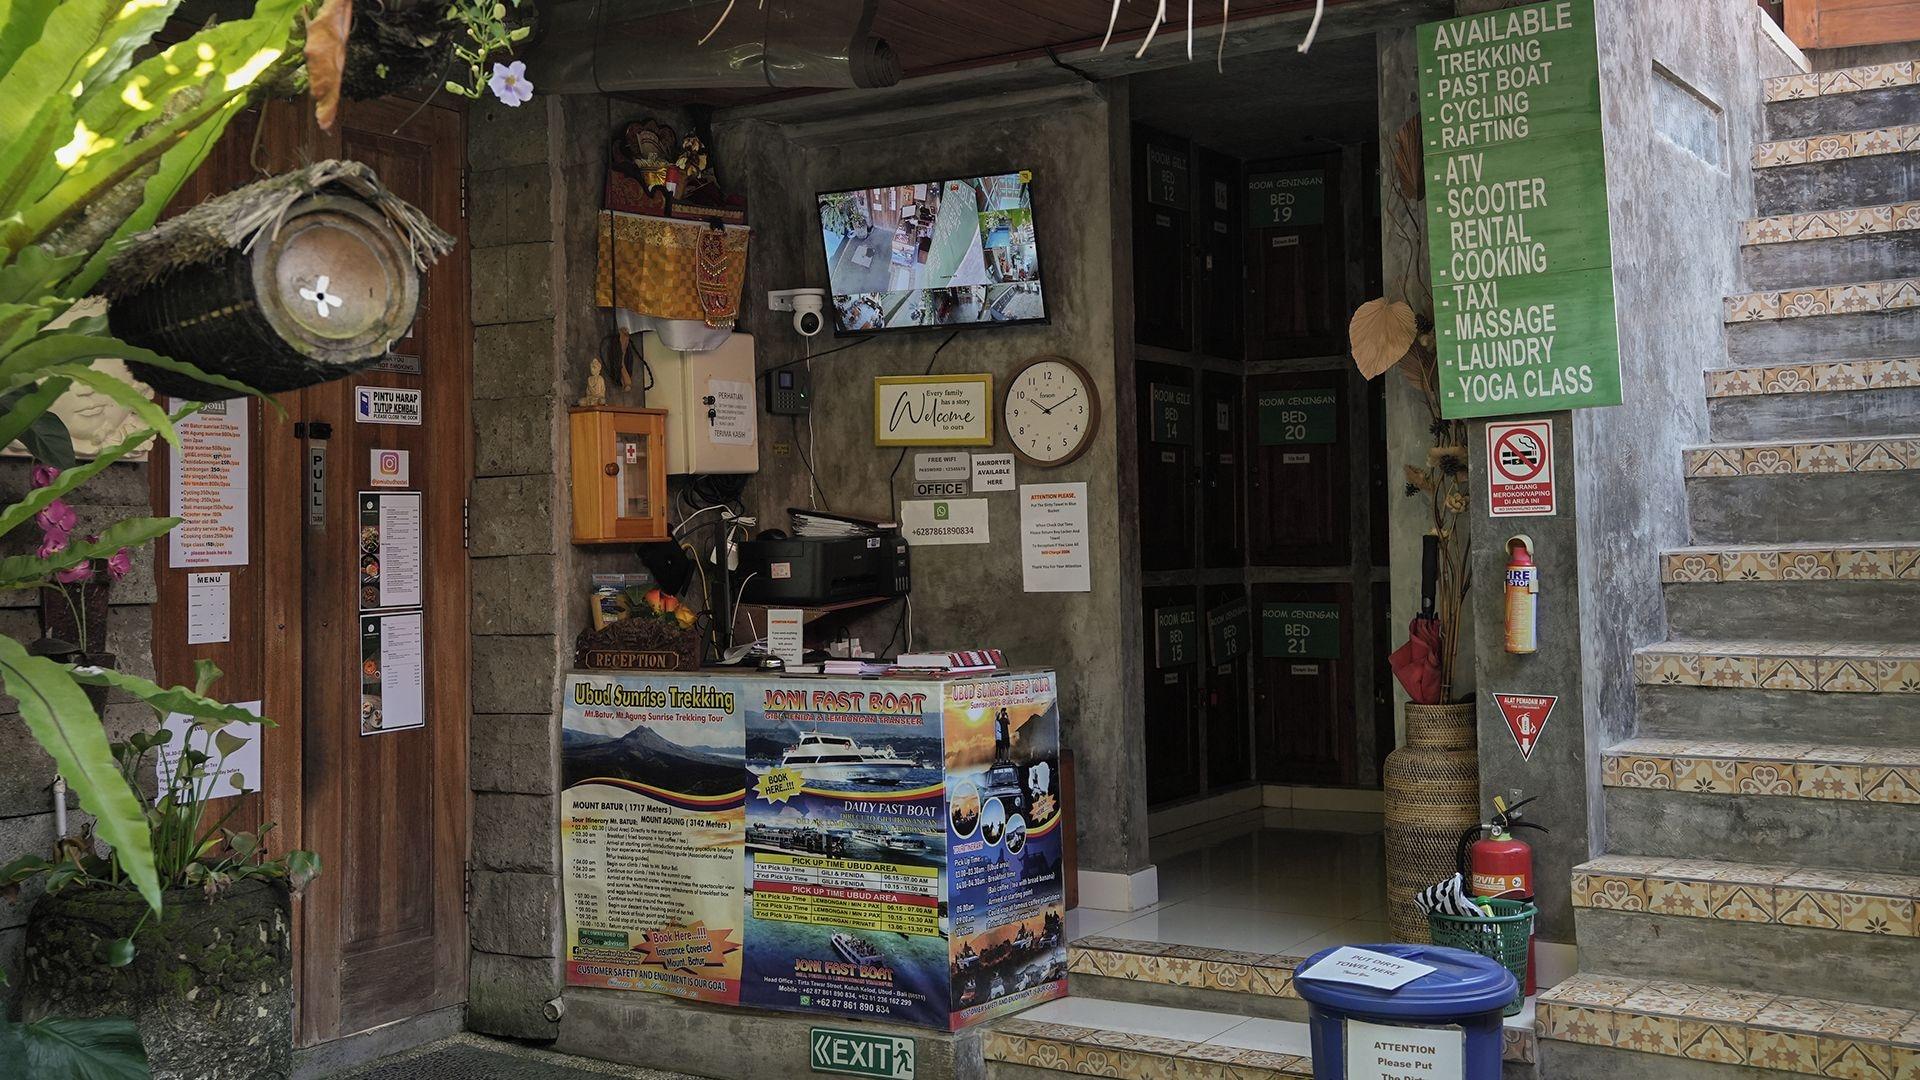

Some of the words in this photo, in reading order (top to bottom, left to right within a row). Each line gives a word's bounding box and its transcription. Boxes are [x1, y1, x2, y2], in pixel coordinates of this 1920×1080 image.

[1434, 3, 1573, 51] AVAILABLE
[1437, 39, 1541, 76] TREKKING
[1438, 72, 1490, 101] PAST
[1496, 62, 1553, 92] BOAT
[1440, 91, 1530, 125] CYCLING
[1442, 116, 1530, 149] RAFTING
[1446, 153, 1484, 186] ATV
[1249, 181, 1274, 190] ROOM
[1276, 176, 1324, 189] CENINGAN
[1270, 192, 1295, 206] BED
[1448, 177, 1548, 218] SCOOTER
[1272, 207, 1293, 222] 19
[1451, 214, 1532, 251] RENTAL
[1451, 242, 1547, 282] COOKING
[1453, 281, 1499, 311] TAXI
[1455, 304, 1557, 340] MASSAGE
[1457, 335, 1554, 371] LAUNDRY
[1028, 377, 1036, 386] 11
[1043, 372, 1052, 380] 12
[1061, 375, 1065, 384] 1
[1459, 372, 1518, 403] YOGA
[1523, 364, 1594, 396] CLASS
[374, 392, 394, 401] PINTU
[395, 393, 418, 403] HARAP
[718, 391, 743, 400] PERHATIAN
[926, 390, 943, 398] Every
[945, 389, 963, 397] family
[1016, 391, 1025, 399] 10
[1072, 388, 1078, 397] 2
[956, 399, 970, 407] story
[1259, 398, 1285, 407] ROOM
[1287, 395, 1336, 406] CENINGAN
[374, 403, 393, 412] TUTUP
[394, 404, 418, 414] KEMBALI
[889, 391, 975, 432] Welcome
[1013, 409, 1019, 417] 9
[1078, 406, 1083, 414] 3
[1281, 410, 1307, 424] BED
[714, 429, 732, 438] TERIMA
[733, 430, 746, 438] KASIH
[1019, 427, 1025, 435] 8
[1073, 424, 1078, 432] 4
[1285, 425, 1306, 440] 20
[1031, 439, 1037, 448] 7
[1046, 444, 1051, 452] 6
[1062, 438, 1068, 447] 5
[313, 455, 322, 506] PULL
[1504, 483, 1538, 491] DILARANG
[917, 483, 963, 495] OFFICE
[1493, 490, 1551, 498] MEROKOK/VAPING
[912, 526, 974, 536] +6287861890834
[197, 576, 221, 584] MENU
[1159, 613, 1180, 627] ROOM
[1262, 609, 1288, 618] ROOM
[1291, 609, 1339, 619] CENINGAN
[1169, 629, 1183, 644] BED
[1284, 623, 1310, 637] BED
[1170, 644, 1183, 661] 15
[1288, 638, 1307, 653] 21
[596, 654, 666, 668] RECEPTION
[952, 684, 975, 701] UBUD
[1031, 677, 1050, 693] TOUR
[575, 682, 612, 706] Ubud
[614, 684, 666, 708] Sunrise
[668, 685, 736, 715] Trekking
[763, 689, 808, 711] JONI
[812, 690, 865, 713] FAST
[868, 692, 927, 716] BOAT
[615, 711, 646, 722] Mt.Agung
[648, 712, 674, 721] Sunrise
[675, 713, 706, 723] Trekking
[708, 715, 724, 723] Tour
[768, 772, 788, 785] BOOK
[573, 801, 599, 810] MOUNT
[601, 802, 624, 811] BATUR
[629, 803, 645, 812] 1717
[646, 804, 668, 814] Meters
[844, 801, 877, 813] DAILY
[879, 803, 903, 815] FAST
[907, 805, 936, 817] BOAT
[640, 816, 662, 824] MOUNT
[662, 817, 685, 825] AGUNG
[689, 818, 705, 827] 3142
[706, 820, 727, 829] Meters
[792, 857, 811, 866] PICK
[825, 860, 845, 869] TIME
[847, 861, 872, 871] UBUD
[874, 864, 898, 873] AREA
[792, 886, 811, 895] PICK
[827, 889, 845, 898] TIME
[846, 890, 872, 899] UBUD
[873, 893, 898, 903] AREA
[653, 931, 673, 942] Book
[655, 946, 685, 957] Insurance
[686, 943, 712, 954] Covered
[1336, 960, 1370, 971] TOWEL
[1371, 966, 1399, 977] HERE
[1351, 954, 1370, 963] PUT
[1372, 957, 1404, 970] DIRTY
[577, 965, 613, 976] CUSTOMER
[613, 968, 639, 978] SAFETY
[639, 970, 653, 979] AND
[654, 972, 687, 985] ENJOYMENT
[687, 975, 694, 984] IS
[694, 976, 708, 987] OUR
[708, 979, 727, 991] GOAL
[816, 998, 831, 1007] +62
[832, 1000, 841, 1008] 87
[843, 1001, 857, 1010] 861
[859, 1002, 874, 1012] 890
[876, 1004, 890, 1014] 834
[833, 1038, 891, 1069] EXIT
[1374, 1041, 1436, 1055] ATTENTION
[1378, 1057, 1412, 1069] Please
[1415, 1059, 1433, 1070] Put
